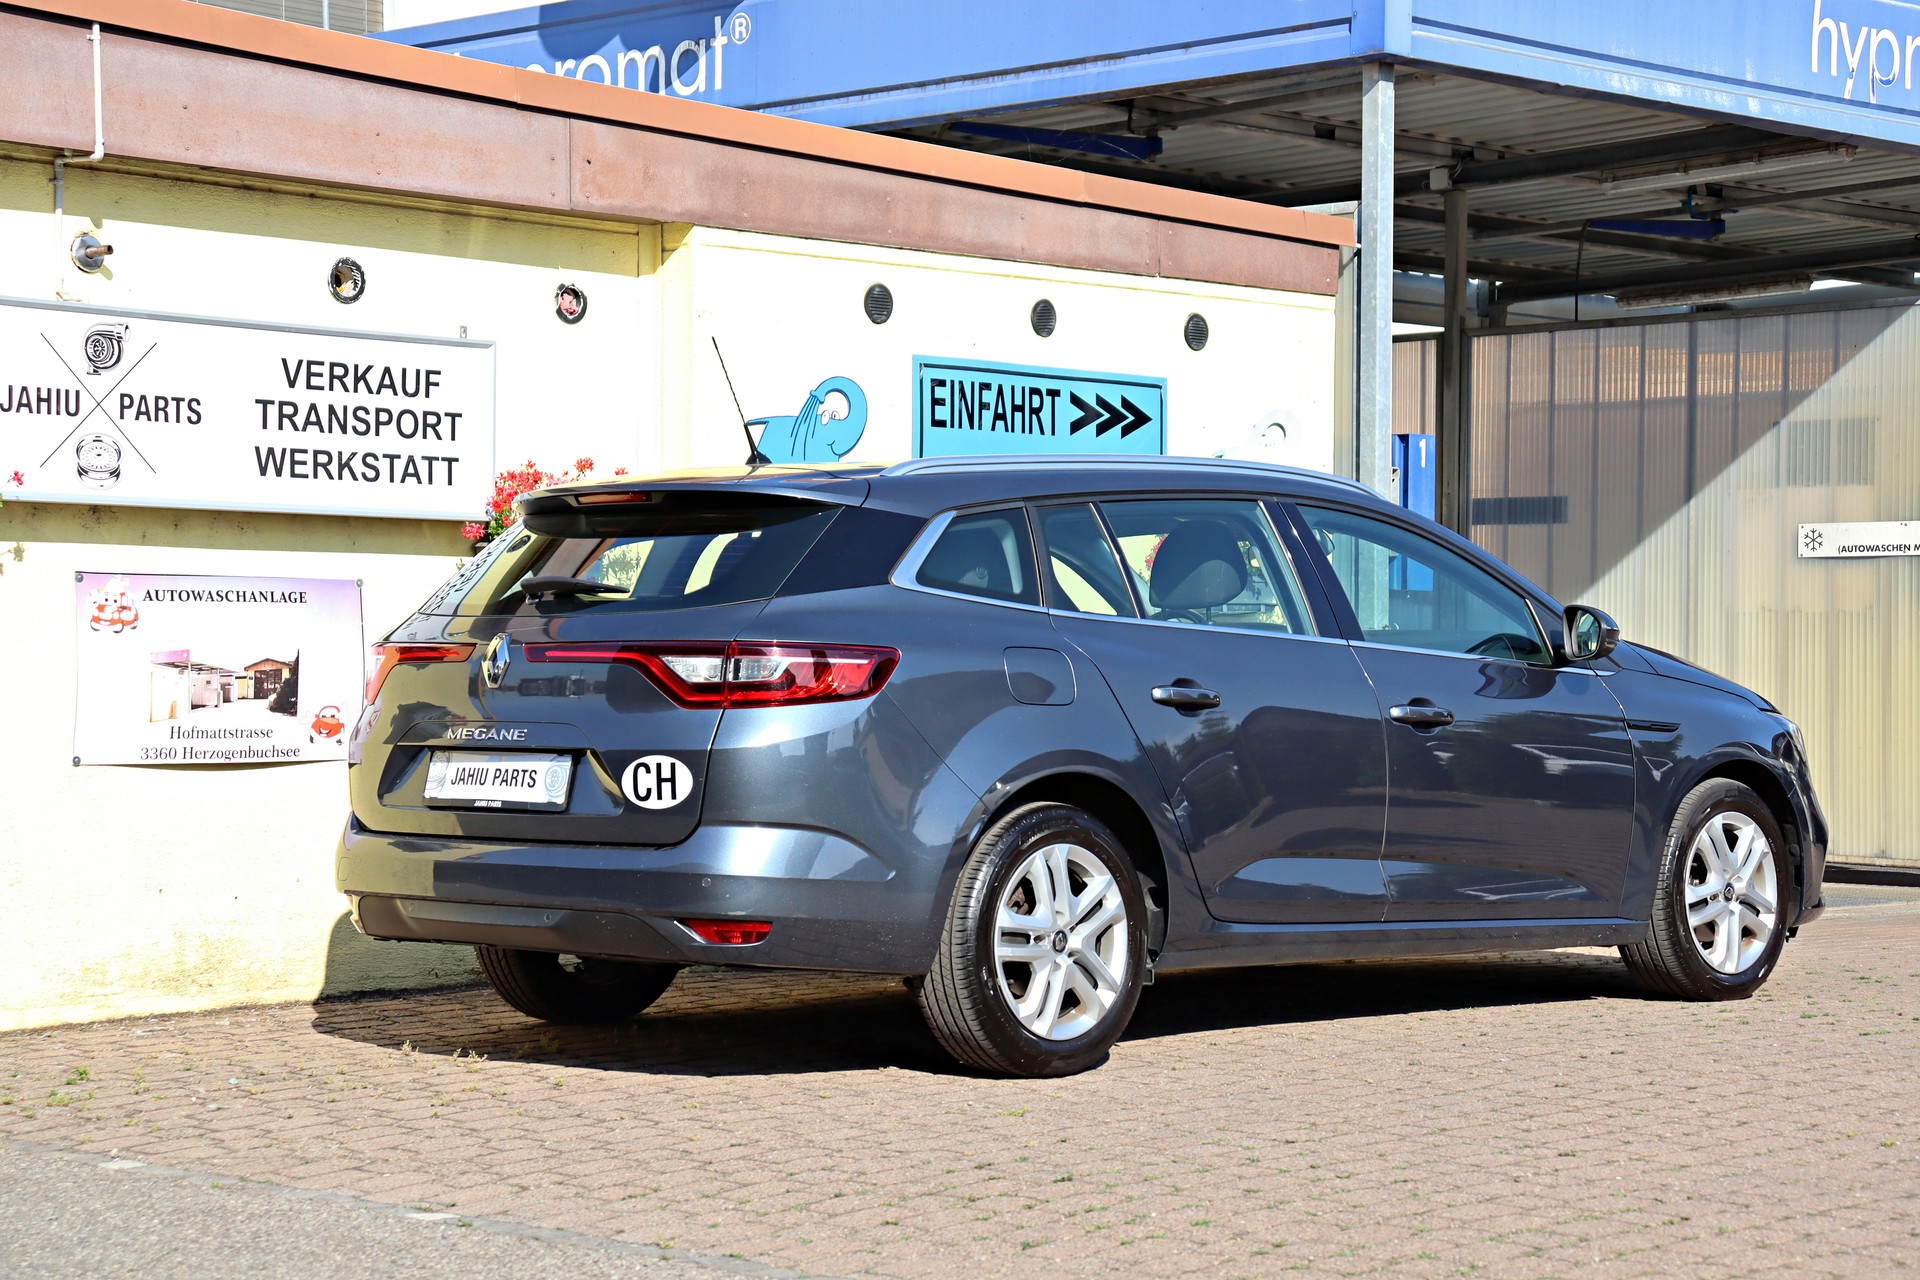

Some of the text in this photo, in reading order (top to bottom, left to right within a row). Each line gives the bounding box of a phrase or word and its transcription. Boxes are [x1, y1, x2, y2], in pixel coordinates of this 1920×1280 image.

[281, 357, 442, 399] VERKAUF
[0, 384, 202, 425] JAHIU PARTS
[930, 377, 1061, 437] EINFAHRT
[254, 398, 463, 442] TRANSPORT
[254, 445, 460, 487] WERKSTATT
[1418, 438, 1427, 468] 1
[1838, 544, 1911, 555] (AUTOWASCHEN
[143, 589, 307, 604] AUTOWASCHANLAGE
[169, 725, 274, 740] Hofmattstrasse
[446, 727, 528, 741] MEGANE
[140, 745, 300, 761] 3360 Herzogenbuchsee
[451, 767, 537, 788] JAHIU PARTS
[631, 761, 678, 802] CH
